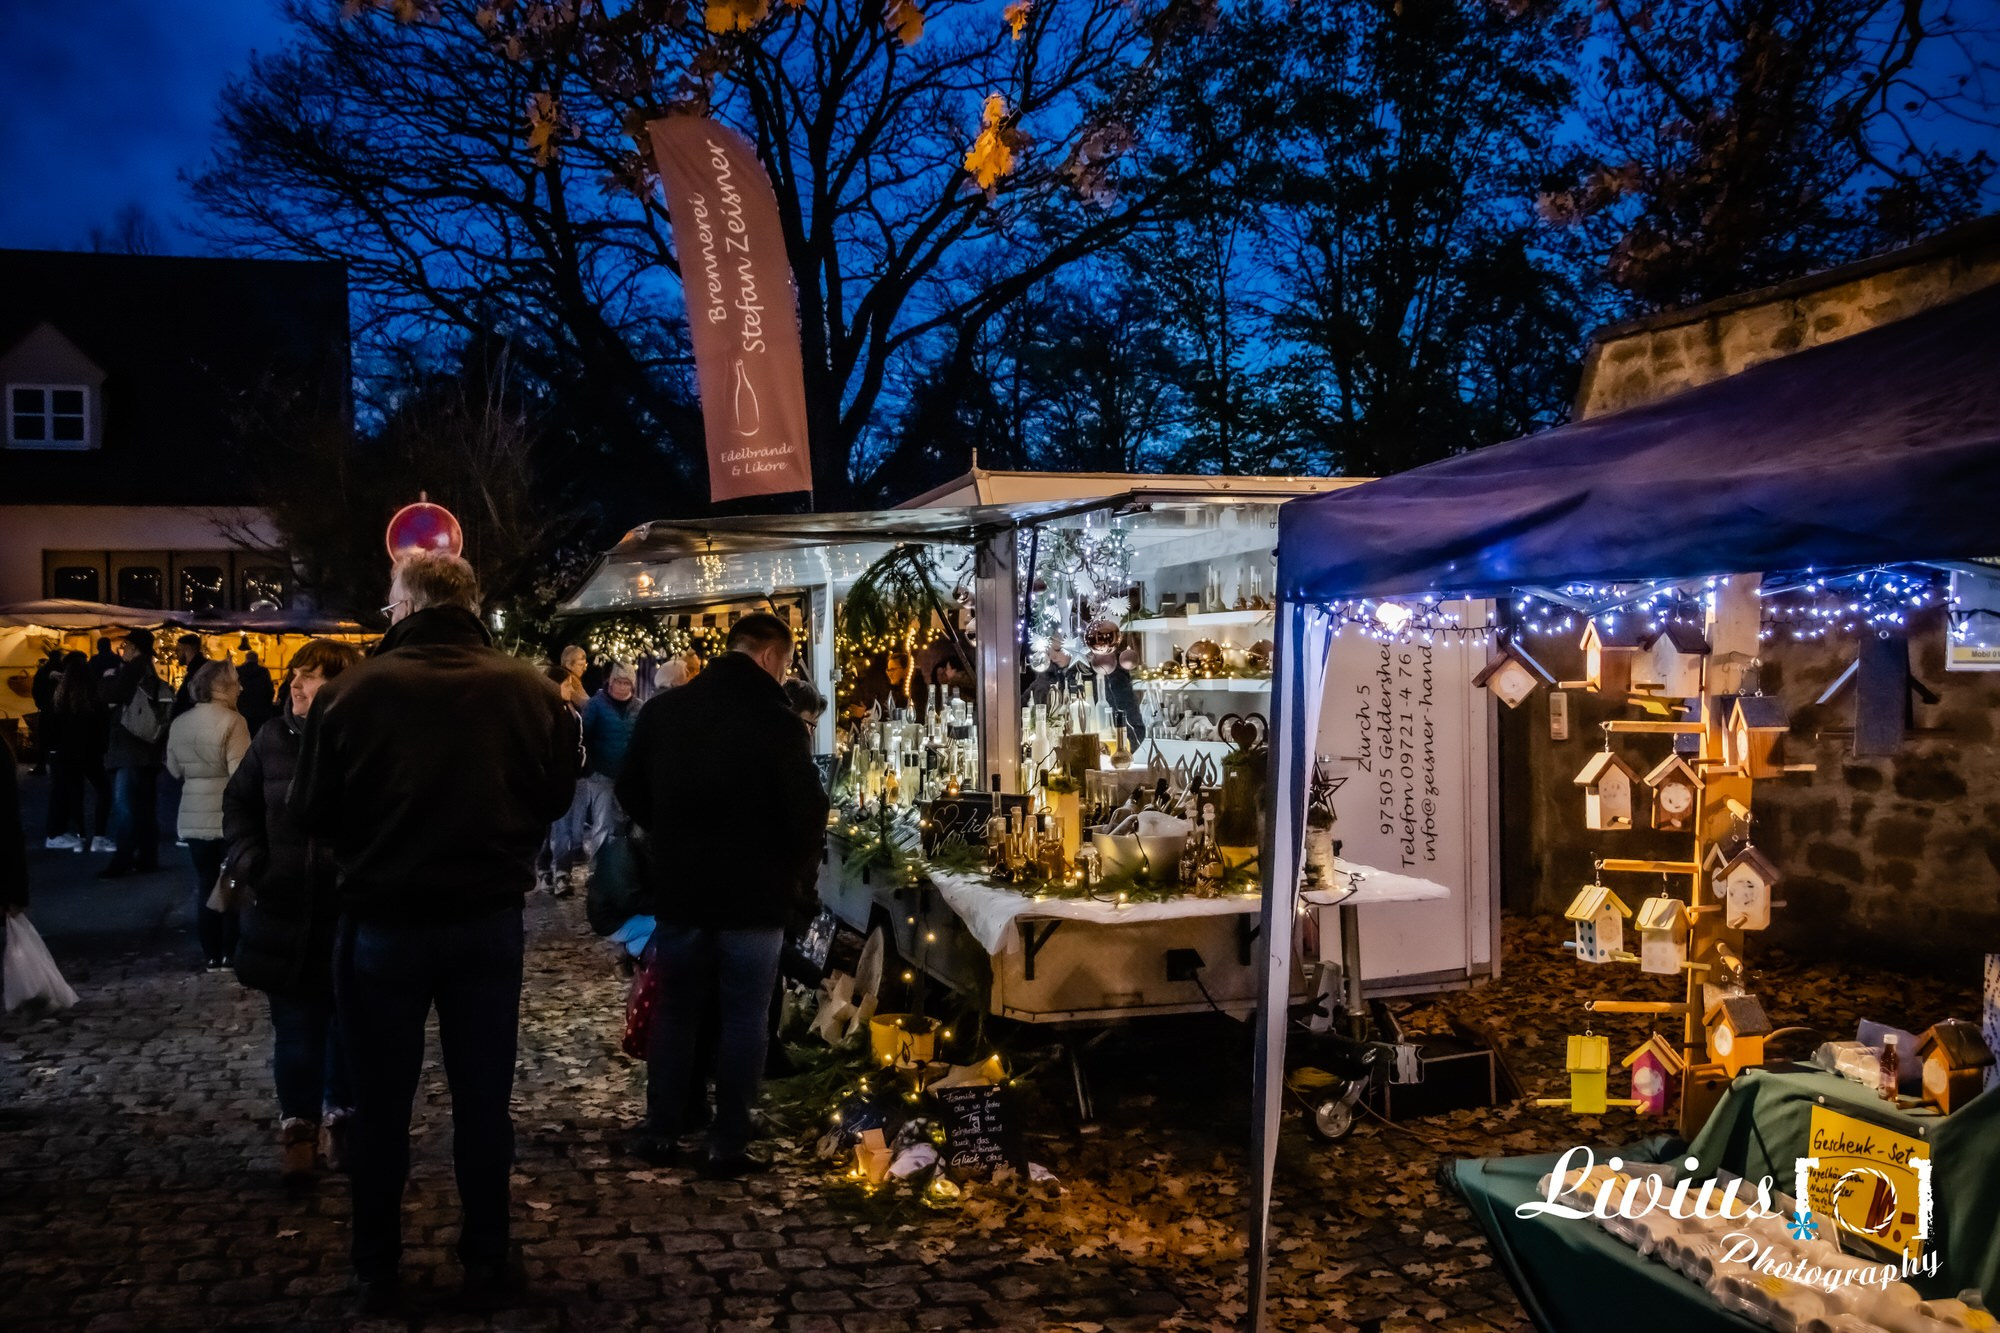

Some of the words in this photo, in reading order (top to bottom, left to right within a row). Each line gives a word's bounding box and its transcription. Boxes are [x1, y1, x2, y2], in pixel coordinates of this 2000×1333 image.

[706, 139, 749, 253] Zeisner
[688, 191, 727, 324] Brennerei
[735, 256, 765, 353] Stefan
[732, 465, 741, 476] &
[1356, 685, 1370, 695] 5
[1376, 640, 1395, 759] Geldershei
[1355, 700, 1371, 773] Zürch
[1400, 713, 1414, 779] 09721
[1379, 768, 1394, 835] 97505
[1399, 782, 1417, 869] Telefon
[1813, 1128, 1876, 1155] Geschenk
[1888, 1142, 1916, 1165] Set
